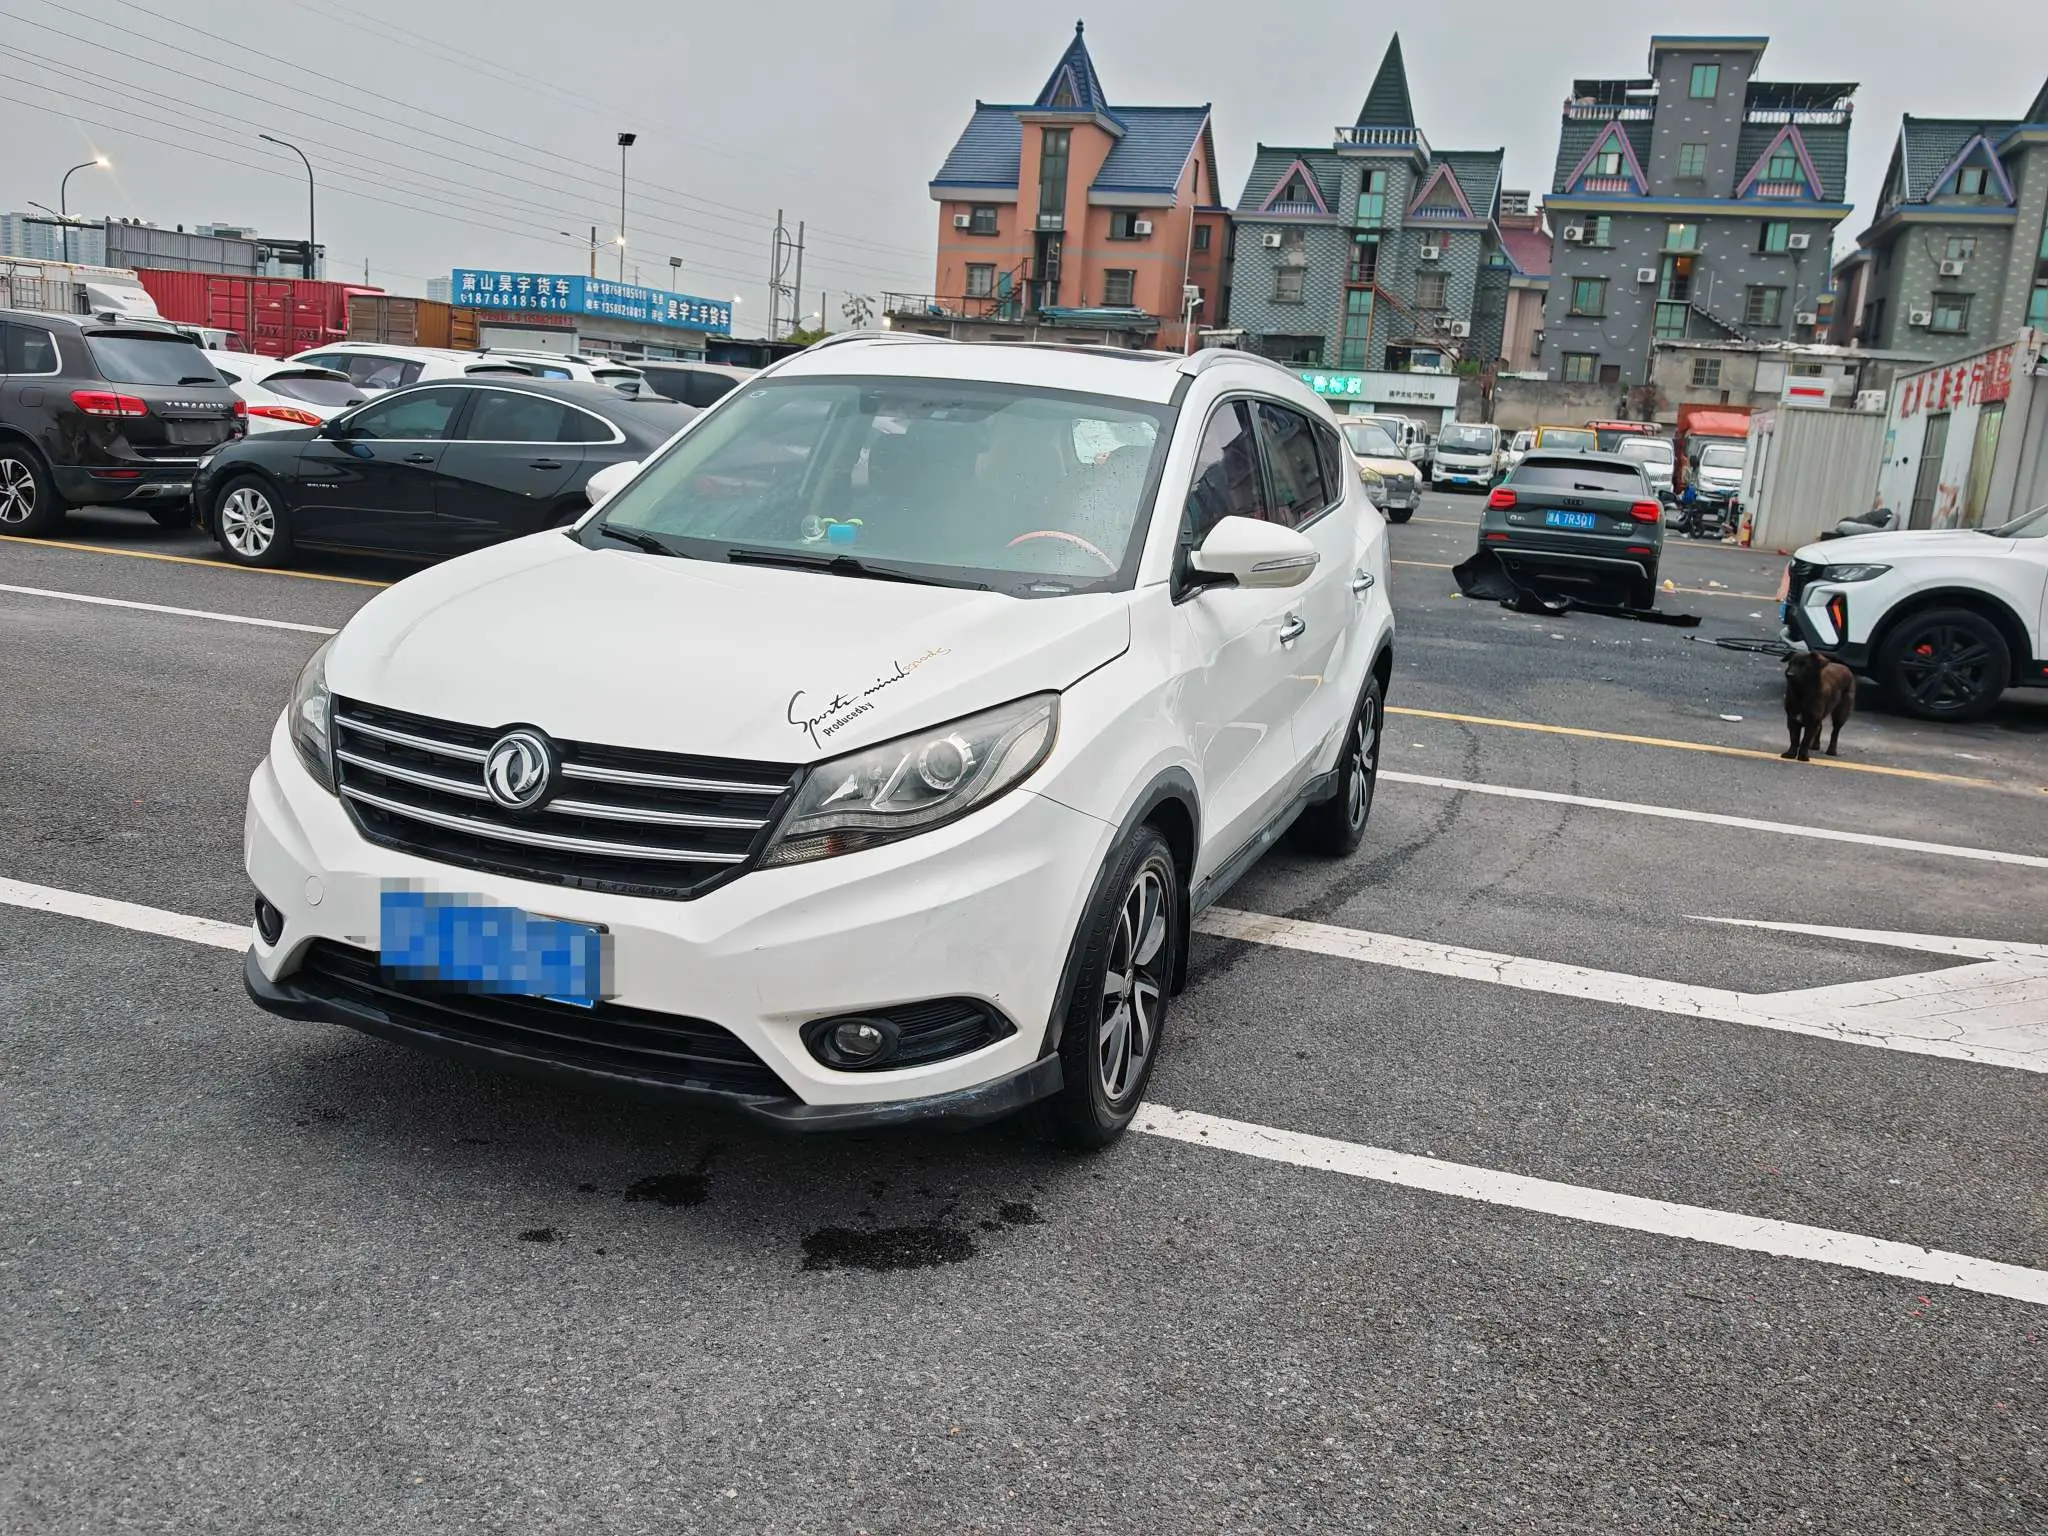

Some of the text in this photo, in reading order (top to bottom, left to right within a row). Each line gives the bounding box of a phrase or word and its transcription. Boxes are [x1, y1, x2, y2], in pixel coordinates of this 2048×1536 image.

[462, 273, 570, 296] 萧山昊宇货车
[468, 292, 567, 309] 18768185610
[667, 299, 729, 327] 昊宇二手货车
